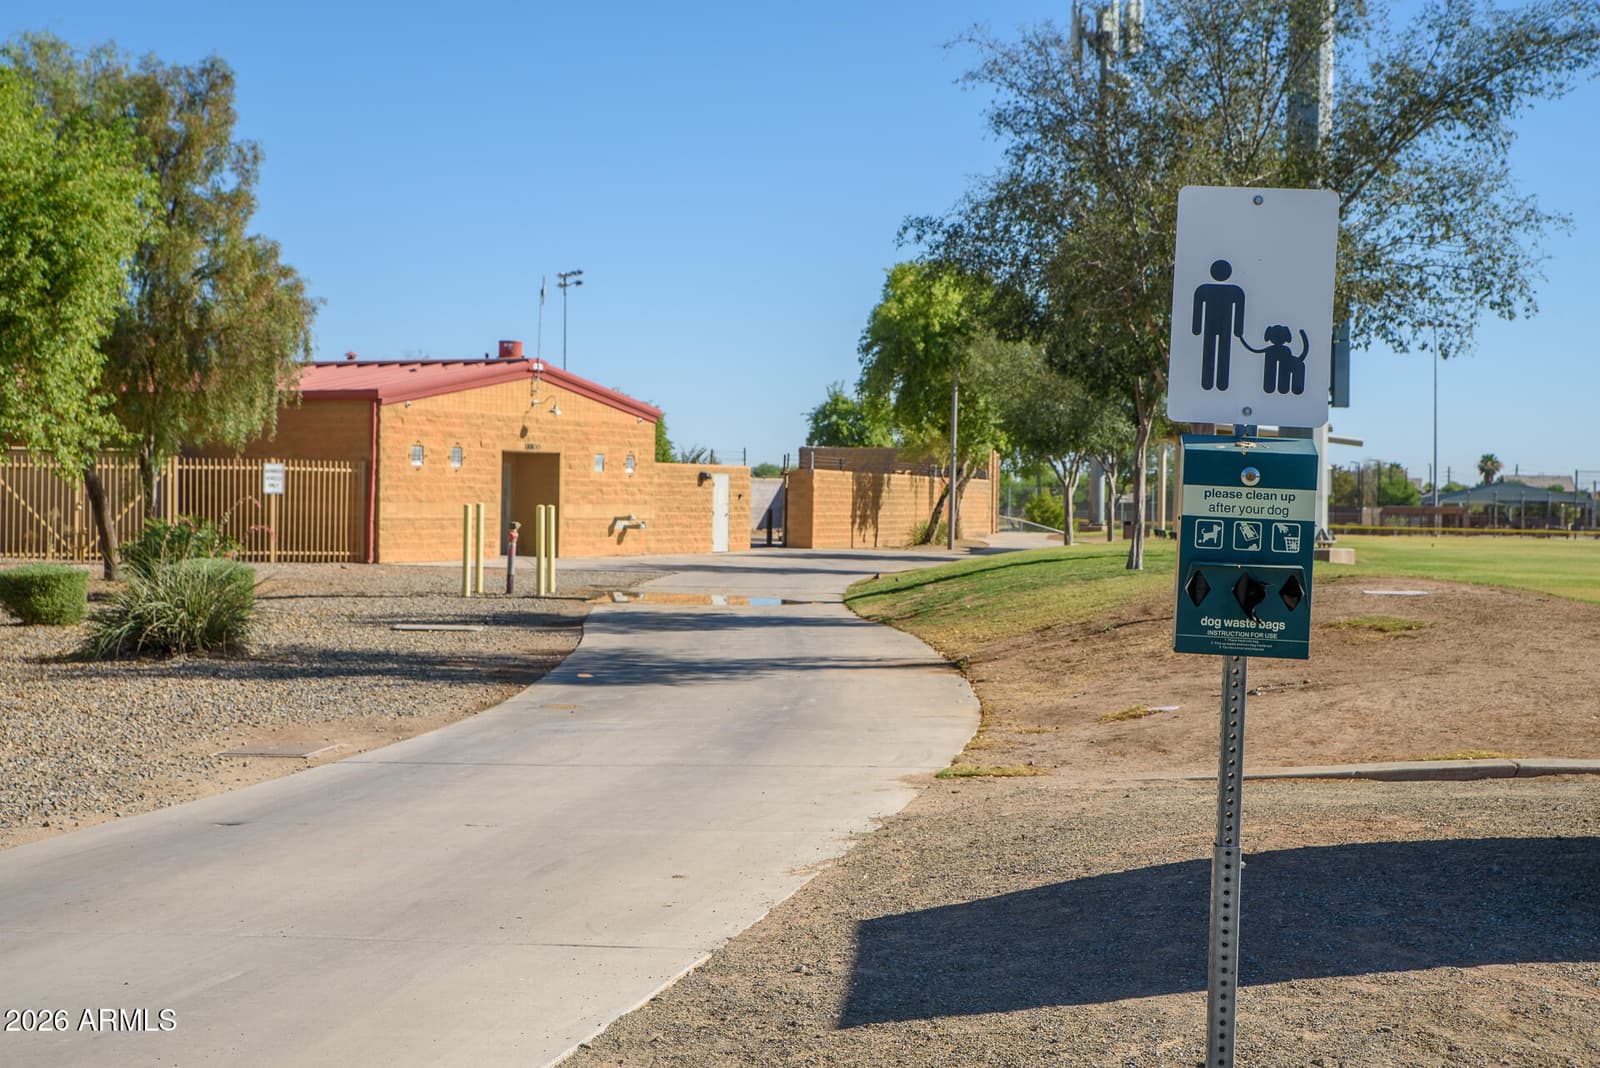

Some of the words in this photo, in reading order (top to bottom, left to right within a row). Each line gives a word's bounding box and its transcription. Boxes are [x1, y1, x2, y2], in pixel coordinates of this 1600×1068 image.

[1204, 488, 1243, 500] please
[1245, 490, 1277, 501] clean
[1280, 493, 1296, 504] up
[1208, 502, 1236, 513] after
[1238, 504, 1265, 516] your
[1267, 504, 1289, 517] dog
[1200, 616, 1222, 629] dog
[1223, 618, 1256, 628] waste
[1258, 619, 1286, 632] bags
